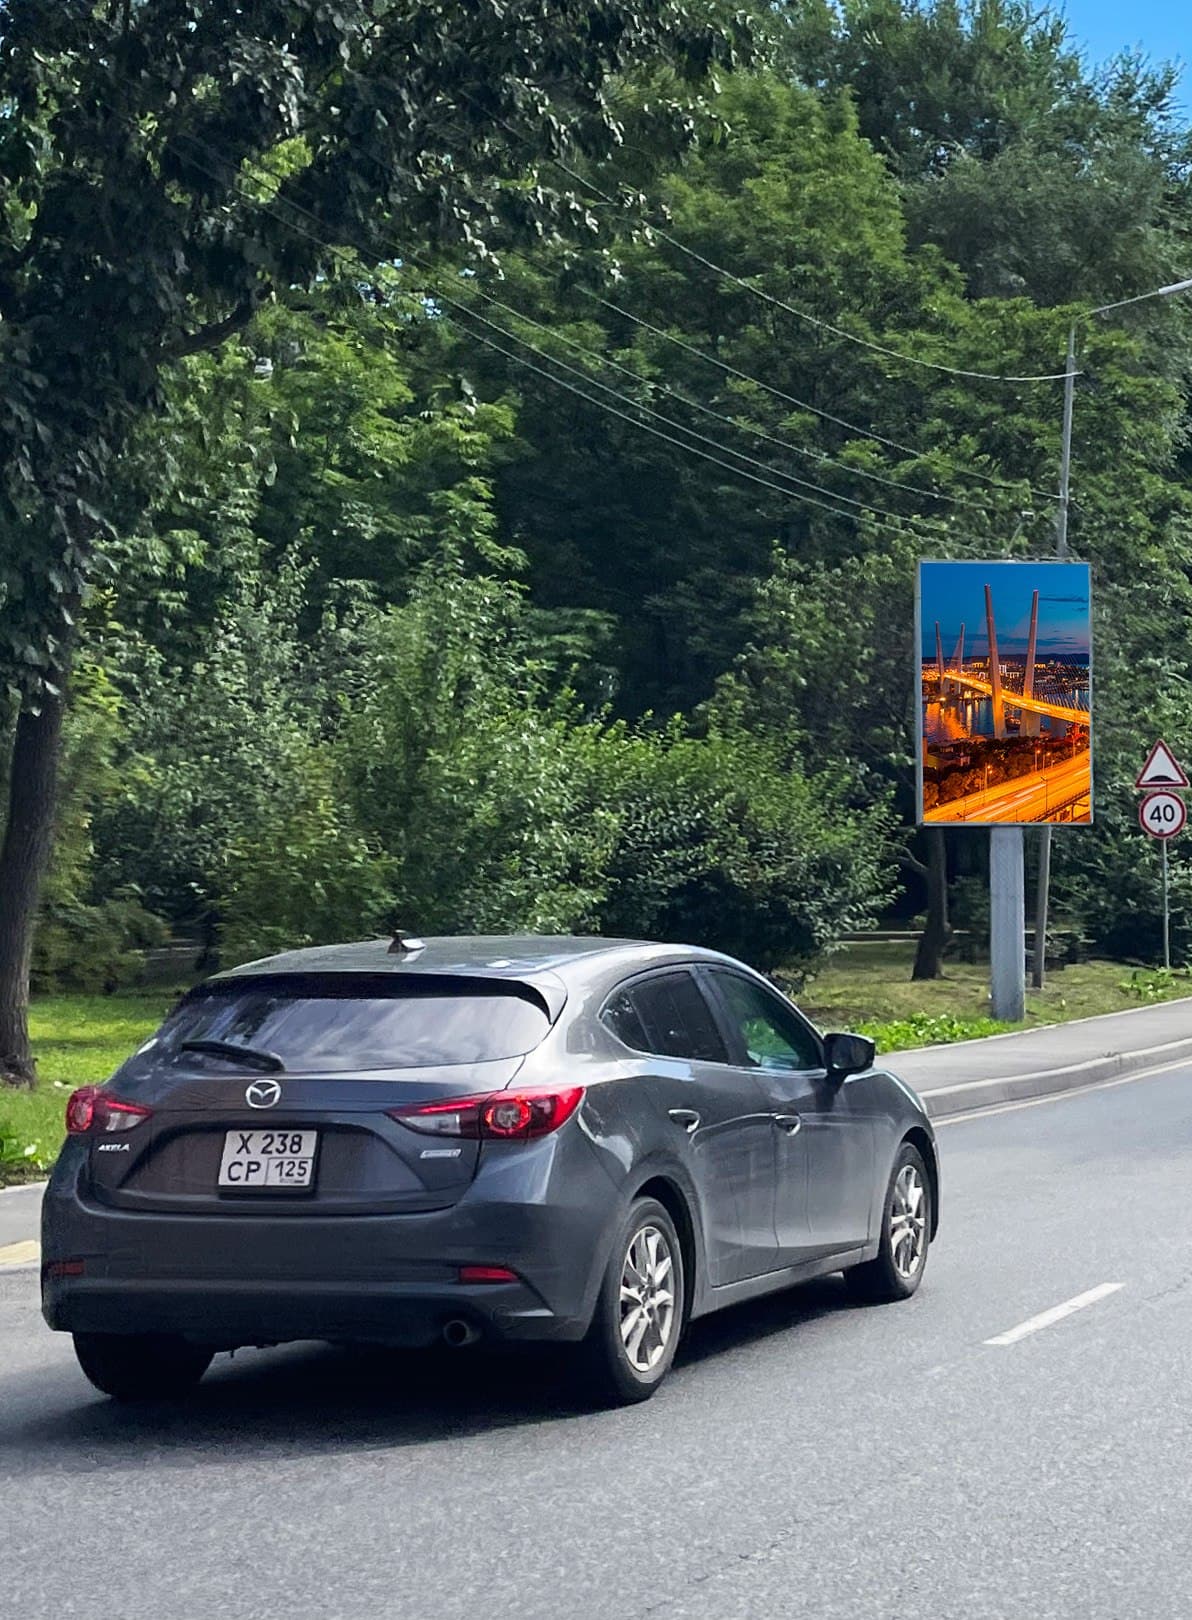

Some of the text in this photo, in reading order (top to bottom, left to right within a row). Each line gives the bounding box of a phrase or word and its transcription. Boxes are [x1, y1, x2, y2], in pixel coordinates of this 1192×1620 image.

[1150, 804, 1175, 823] 40
[260, 1133, 303, 1154] 238
[275, 1161, 309, 1177] 125
